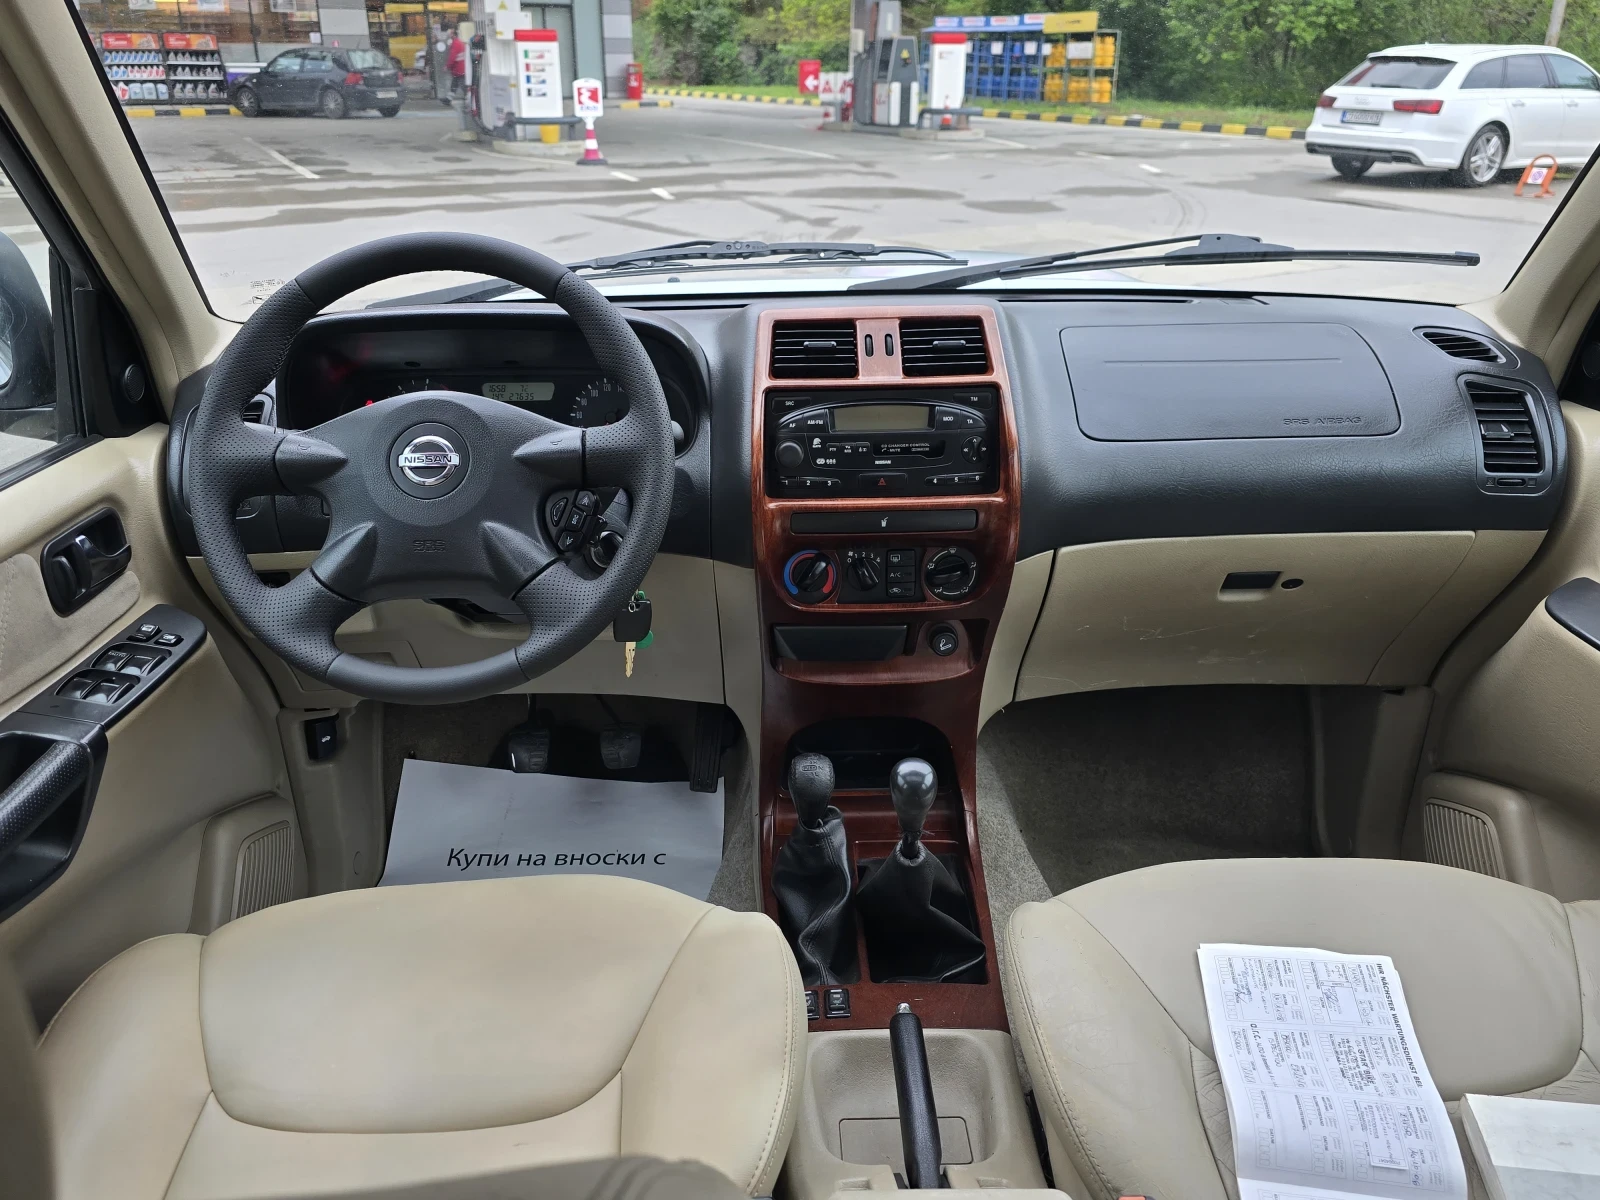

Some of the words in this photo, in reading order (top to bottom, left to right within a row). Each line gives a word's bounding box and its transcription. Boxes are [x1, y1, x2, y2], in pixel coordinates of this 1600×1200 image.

[446, 847, 510, 871] Купи
[516, 853, 547, 867] на
[554, 850, 646, 866] вноски
[653, 853, 667, 865] с
[1380, 977, 1395, 1011] NÄCHSTER
[1391, 1014, 1417, 1074] WARTUNGSDIENST
